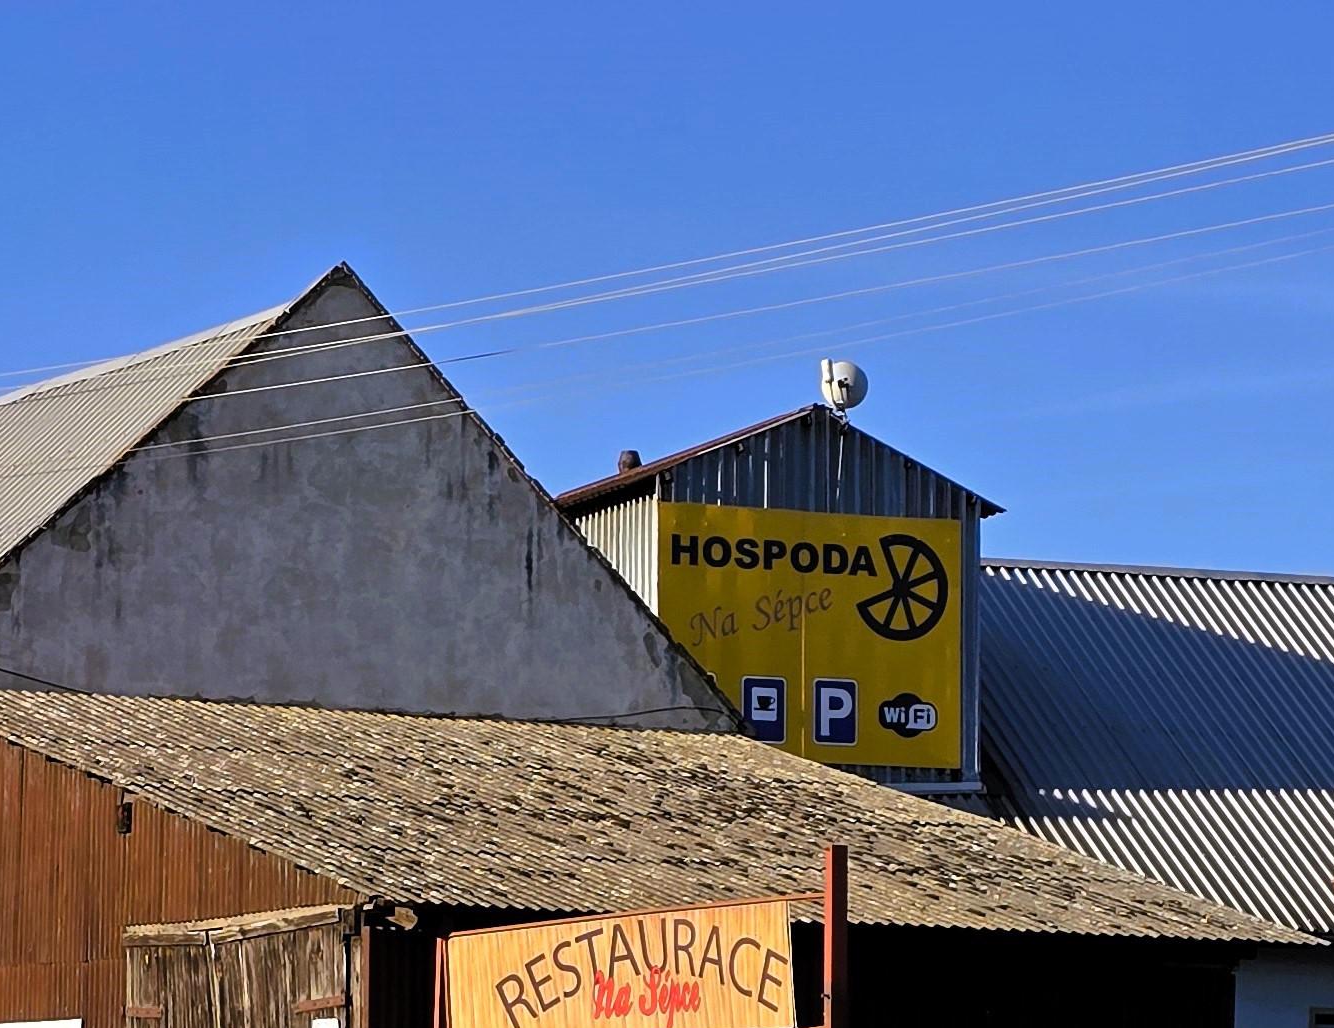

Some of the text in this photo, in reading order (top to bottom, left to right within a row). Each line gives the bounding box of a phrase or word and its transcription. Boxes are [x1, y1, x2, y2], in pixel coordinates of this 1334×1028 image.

[671, 533, 878, 577] HOSPODA
[690, 587, 834, 647] Na Sépce
[820, 687, 853, 737] P
[594, 969, 633, 1019] Na
